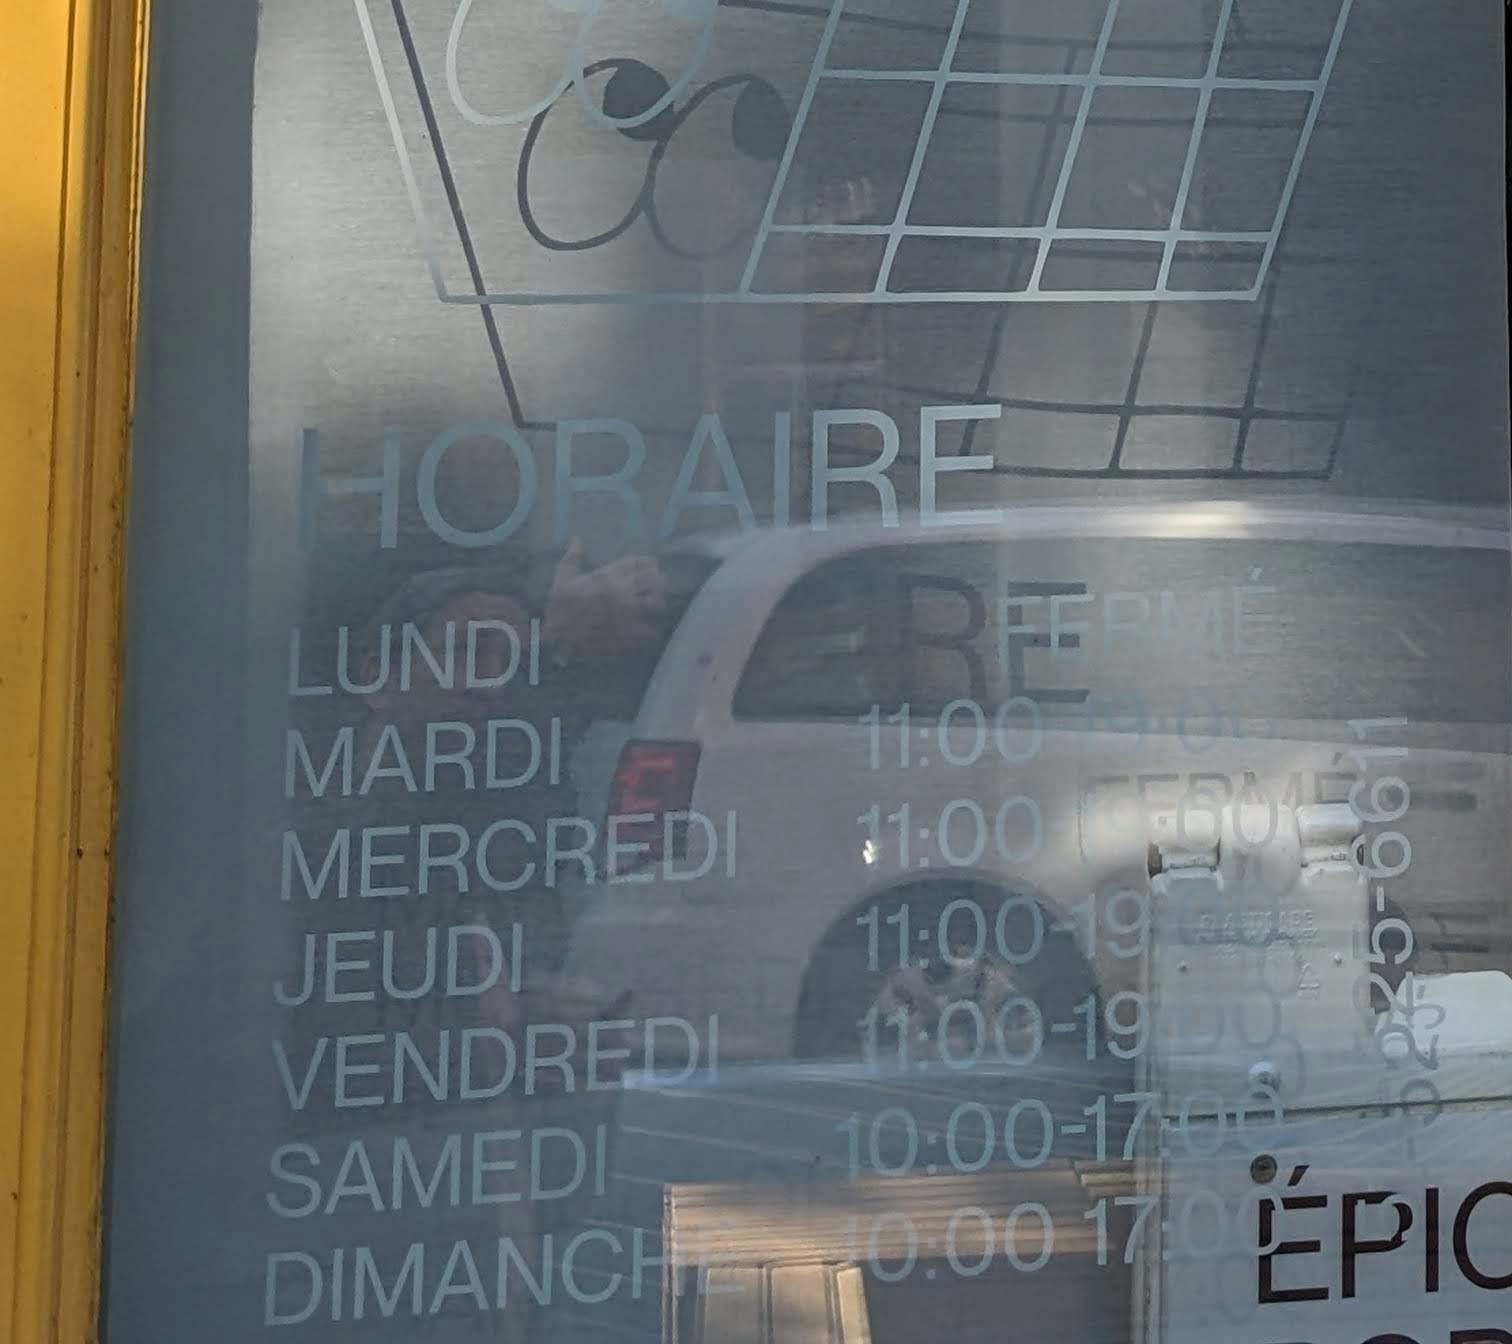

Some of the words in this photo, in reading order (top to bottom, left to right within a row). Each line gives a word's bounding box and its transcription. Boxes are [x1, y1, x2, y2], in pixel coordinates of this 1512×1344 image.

[300, 403, 1000, 553] HORAIRE
[287, 617, 542, 698] LUNDI
[283, 715, 563, 799] MARDI
[279, 809, 738, 902] MERCREDI
[272, 922, 524, 1008] JEUDI
[272, 1013, 719, 1112] VENDREDI
[265, 1123, 608, 1220] SAMEDI
[840, 1185, 1285, 1284] 10:0017:00
